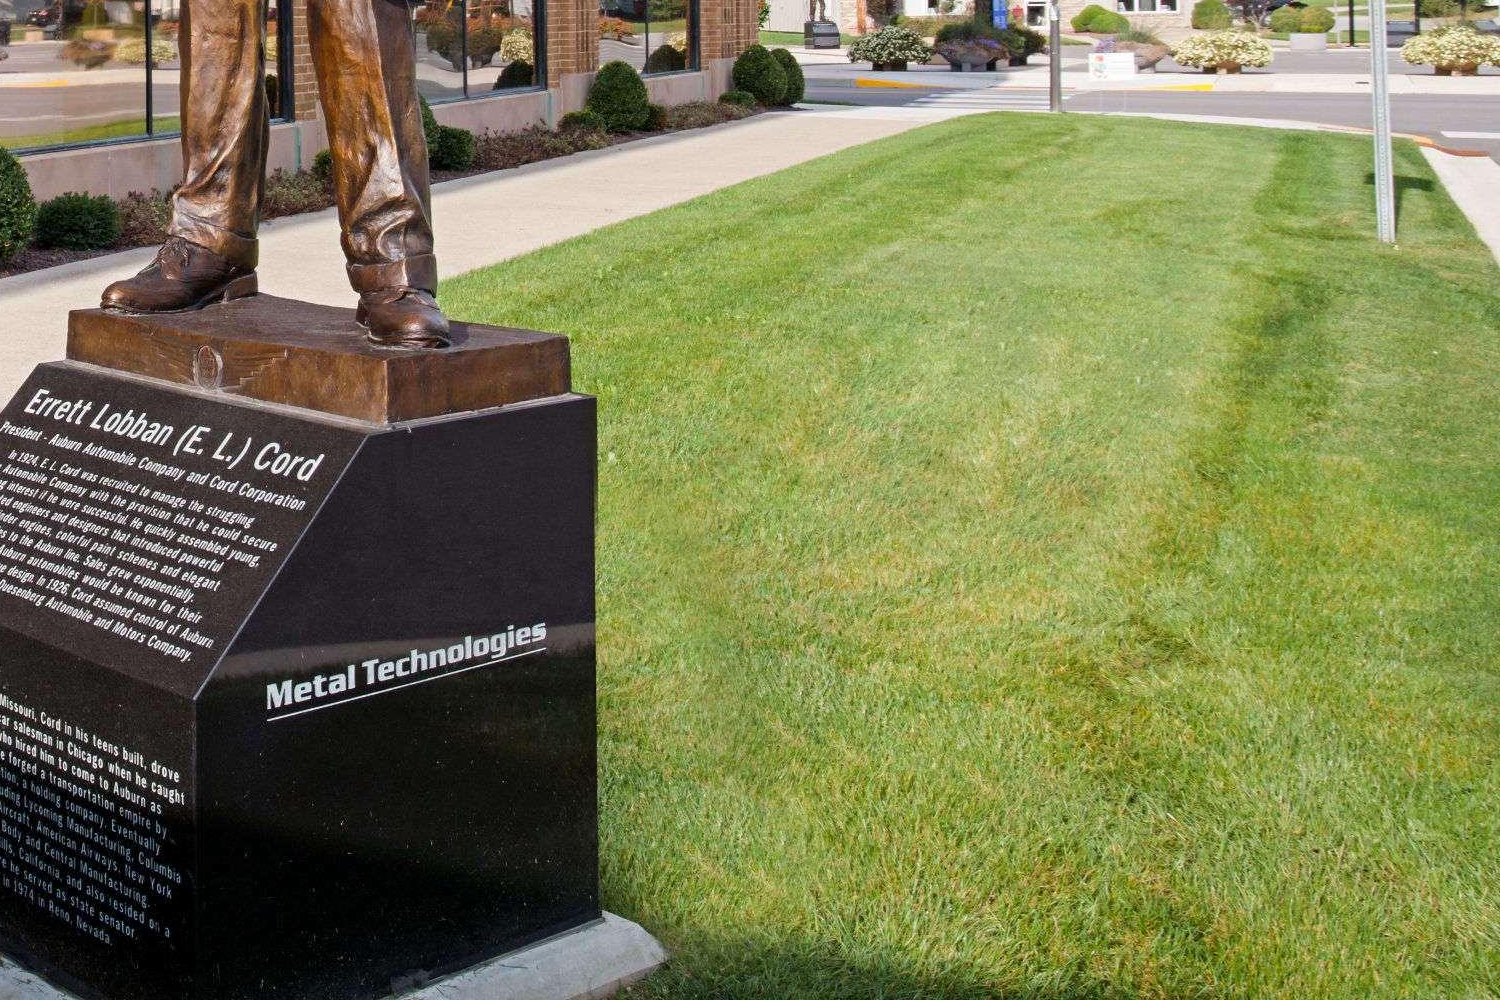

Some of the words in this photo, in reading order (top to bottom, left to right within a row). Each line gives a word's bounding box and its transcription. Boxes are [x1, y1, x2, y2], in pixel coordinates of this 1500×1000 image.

[24, 388, 92, 424] Errett
[90, 403, 173, 445] Lobban
[172, 424, 211, 455] (E.
[211, 431, 252, 469] L.)
[253, 442, 324, 481] Cord
[2, 463, 47, 484] Automobile
[48, 476, 87, 497] Company
[88, 490, 109, 501] with
[110, 494, 126, 507] the
[125, 501, 171, 519] provision
[172, 512, 195, 527] that
[211, 526, 241, 540] could
[241, 534, 278, 552] secure
[47, 433, 82, 451] Auburn
[81, 442, 136, 465] Automobile
[137, 456, 185, 481] Company
[185, 471, 210, 485] and
[208, 474, 239, 492] Cord
[238, 482, 306, 510] Corporation
[58, 462, 81, 477] Cord
[80, 471, 98, 482] was
[98, 476, 140, 493] recruited
[150, 490, 186, 508] manage
[187, 499, 204, 512] the
[205, 506, 255, 529] struggling
[6, 482, 39, 497] interest
[59, 498, 80, 510] were
[143, 523, 176, 541] quickly
[176, 533, 229, 555] assembled
[11, 500, 50, 517] engineers
[50, 512, 69, 523] and
[67, 515, 109, 536] designers
[110, 528, 131, 543] that
[130, 537, 181, 558] introduced
[177, 552, 224, 572] powerful
[18, 534, 33, 547] the
[33, 538, 63, 556] Auburn
[82, 554, 107, 571] Sales
[106, 565, 132, 579] grew
[26, 556, 79, 579] automobiles
[81, 574, 111, 590] would
[124, 587, 156, 607] known
[157, 599, 175, 613] for
[176, 606, 202, 623] their
[55, 530, 92, 547] colorful
[88, 541, 116, 556] paint
[116, 550, 158, 570] schemes
[159, 564, 181, 577] and
[181, 571, 221, 591] elegant
[44, 596, 93, 622] Automobile
[92, 616, 114, 630] and
[111, 621, 146, 643] Motors
[71, 586, 94, 603] Cord
[92, 597, 134, 618] assumed
[132, 612, 168, 630] control
[179, 627, 214, 648] Auburn
[266, 664, 356, 710] Metal
[362, 621, 547, 686] Technologies
[13, 720, 53, 745] salesman
[66, 741, 103, 769] Chicago
[107, 762, 131, 781] when
[150, 781, 185, 805] caught
[14, 736, 37, 757] hired
[39, 747, 54, 765] him
[70, 765, 95, 784] come
[112, 781, 146, 807] Auburn
[39, 710, 61, 731] Cord
[74, 725, 88, 743] his
[92, 734, 119, 756] teens
[150, 759, 180, 783] drove
[8, 751, 37, 775] forged
[49, 771, 114, 811] transportation
[118, 806, 151, 829] empire
